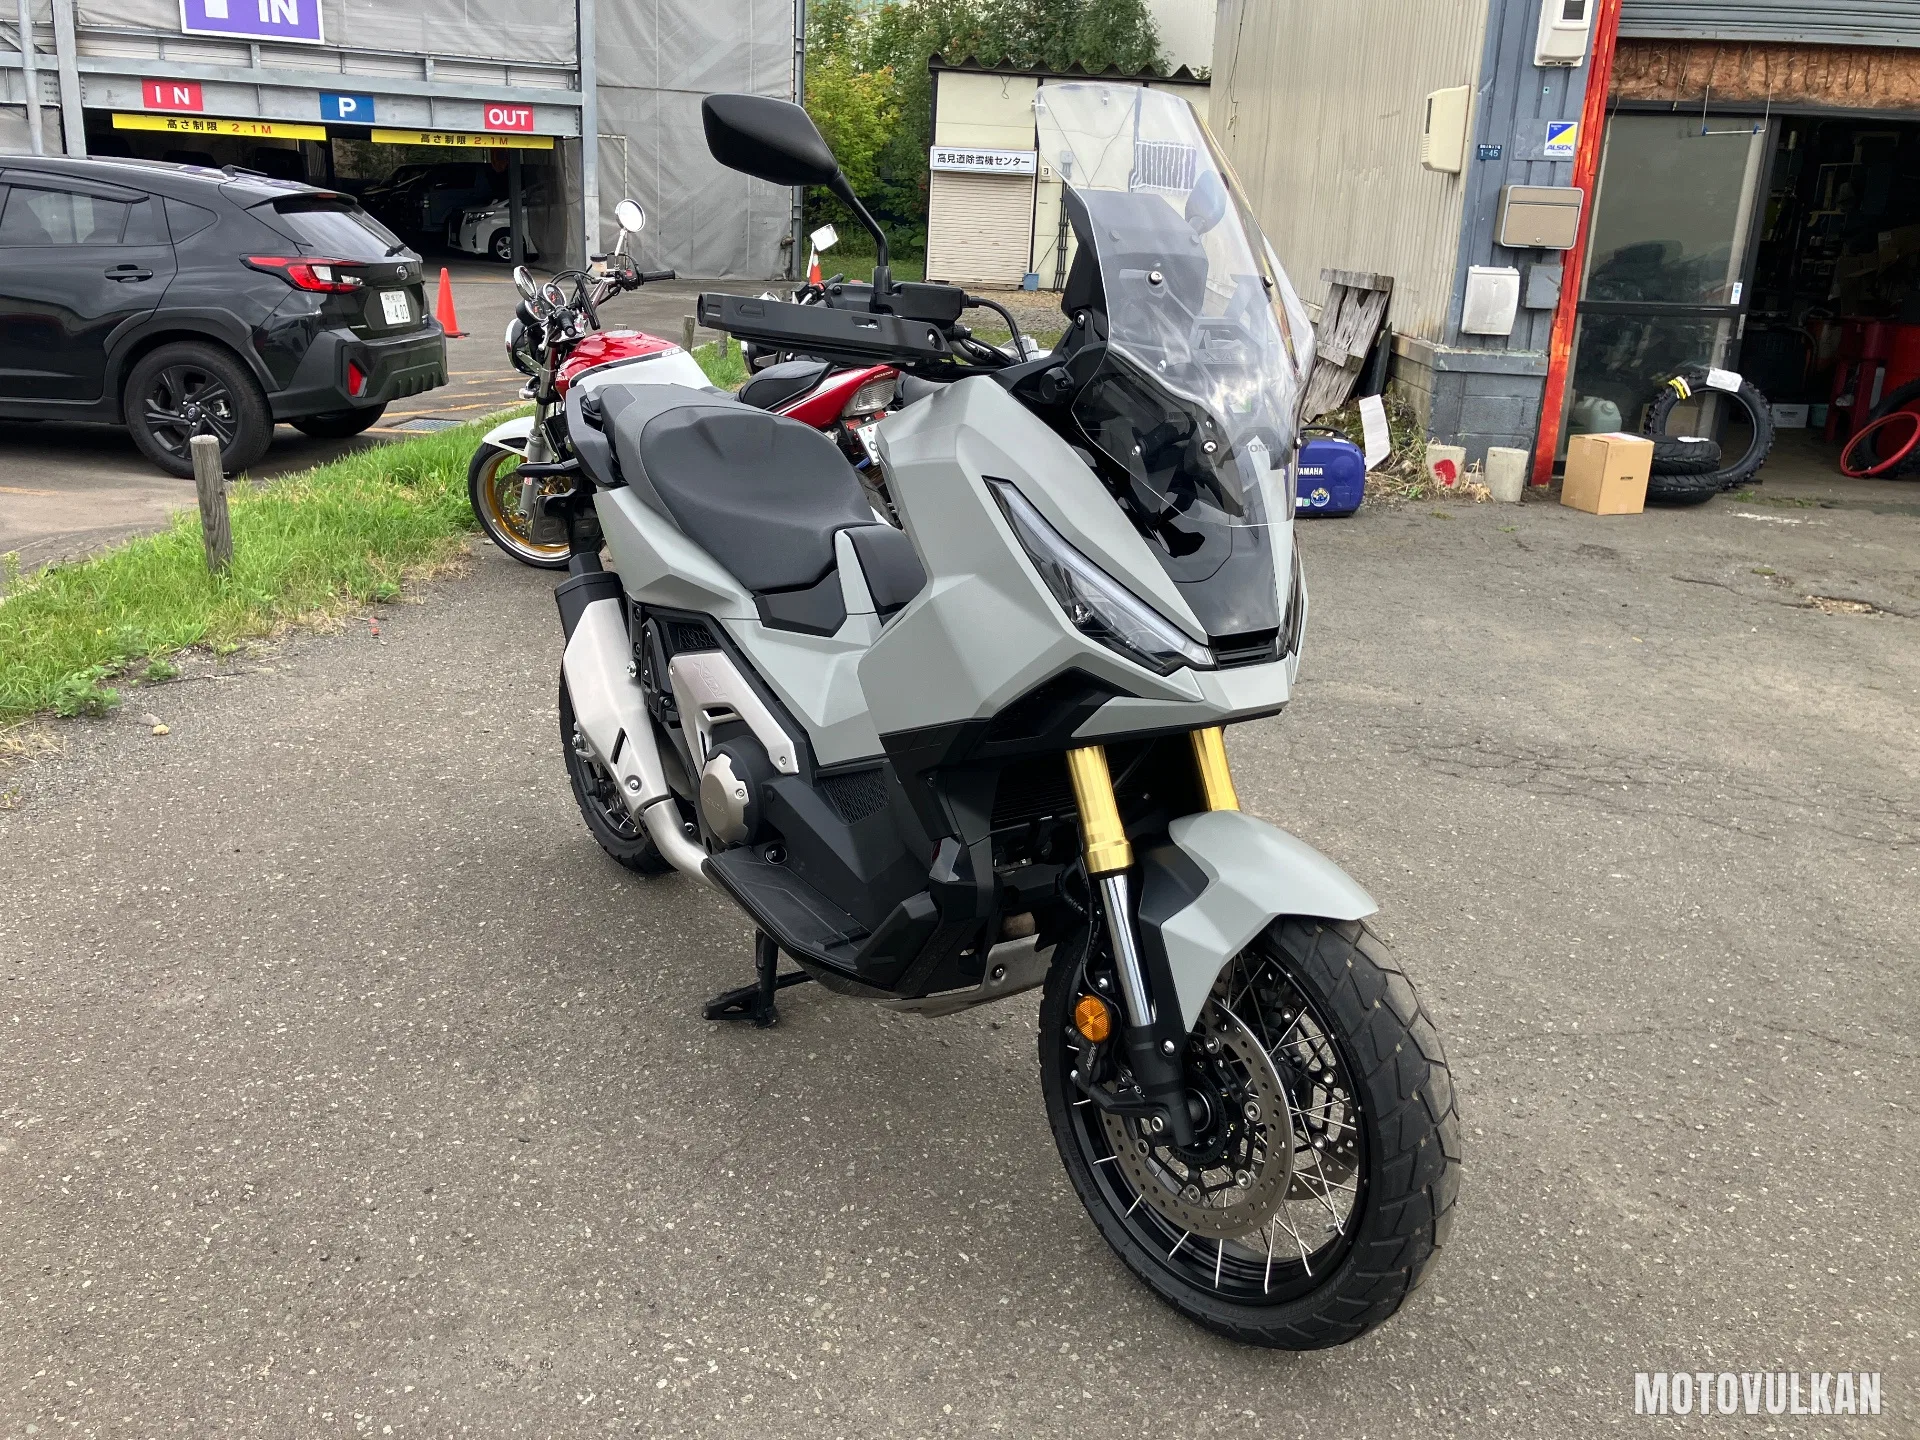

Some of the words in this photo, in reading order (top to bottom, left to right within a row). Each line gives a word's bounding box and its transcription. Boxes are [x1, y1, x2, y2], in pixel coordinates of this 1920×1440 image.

[258, 0, 299, 25] IN
[154, 85, 190, 105] IN
[338, 97, 357, 118] P
[166, 118, 218, 131] 高さ制限
[231, 123, 272, 134] 2.1M
[488, 108, 530, 126] OUT
[420, 133, 467, 145] 高さ制限
[474, 136, 509, 146] 2.1M
[1480, 149, 1498, 157] 1-45
